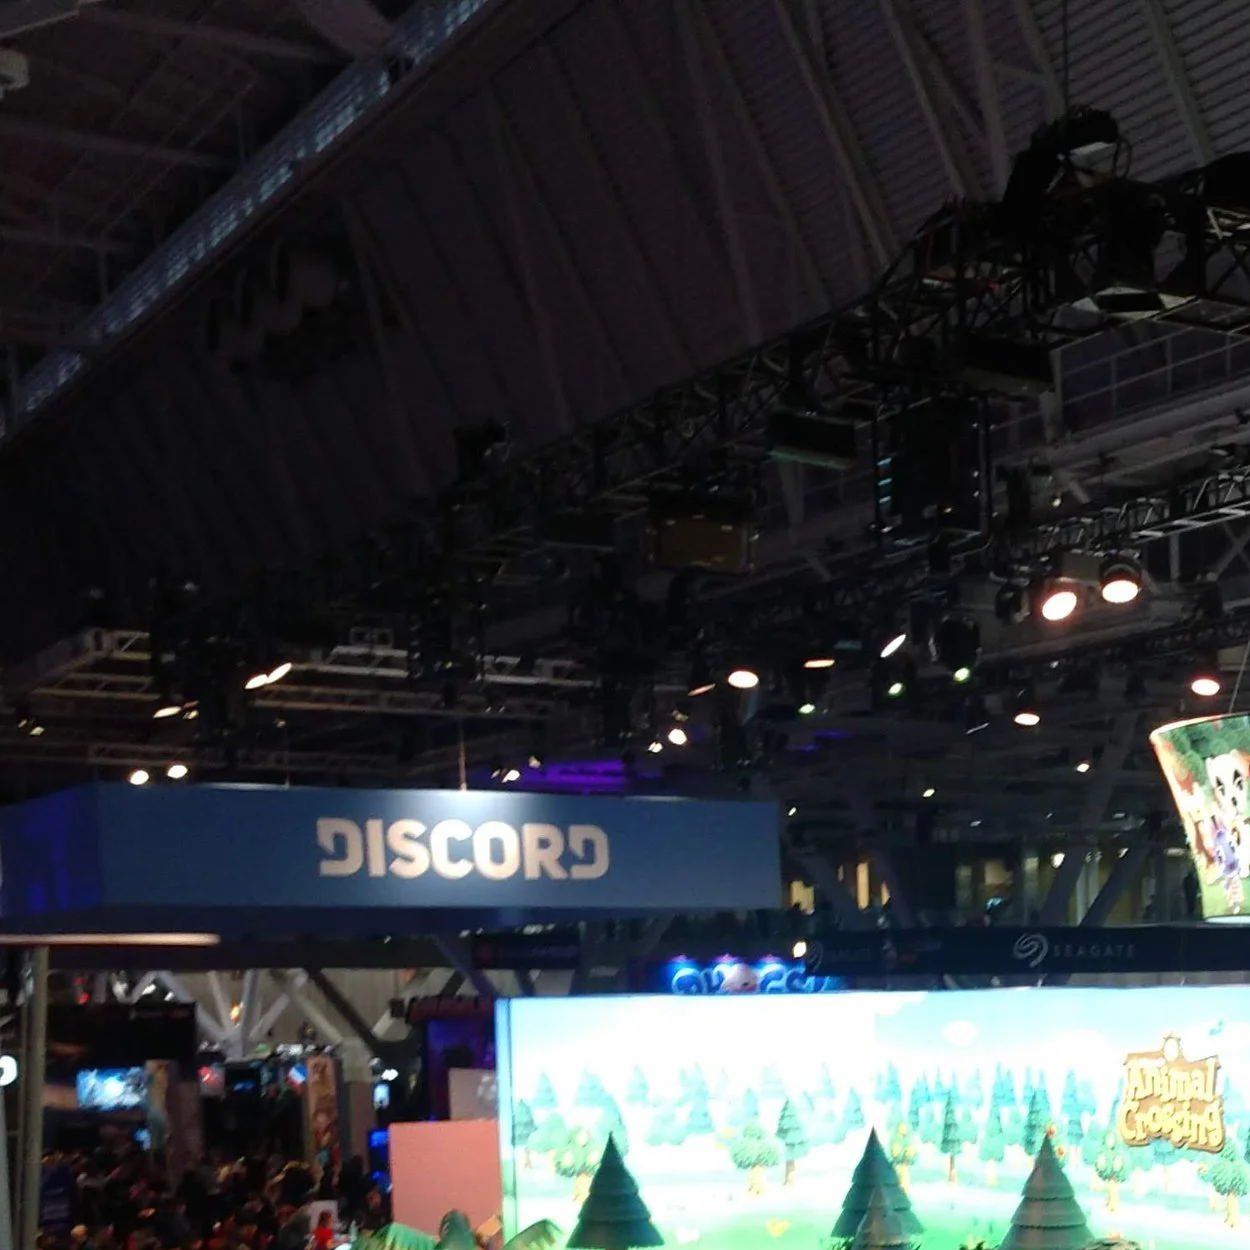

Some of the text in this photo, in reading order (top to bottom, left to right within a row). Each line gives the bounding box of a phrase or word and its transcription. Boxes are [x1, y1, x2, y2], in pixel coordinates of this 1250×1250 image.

[316, 817, 610, 881] DISCORD
[1053, 944, 1136, 959] SEAGATE
[1125, 1058, 1218, 1103] Animal
[1119, 1099, 1223, 1147] Crossing
